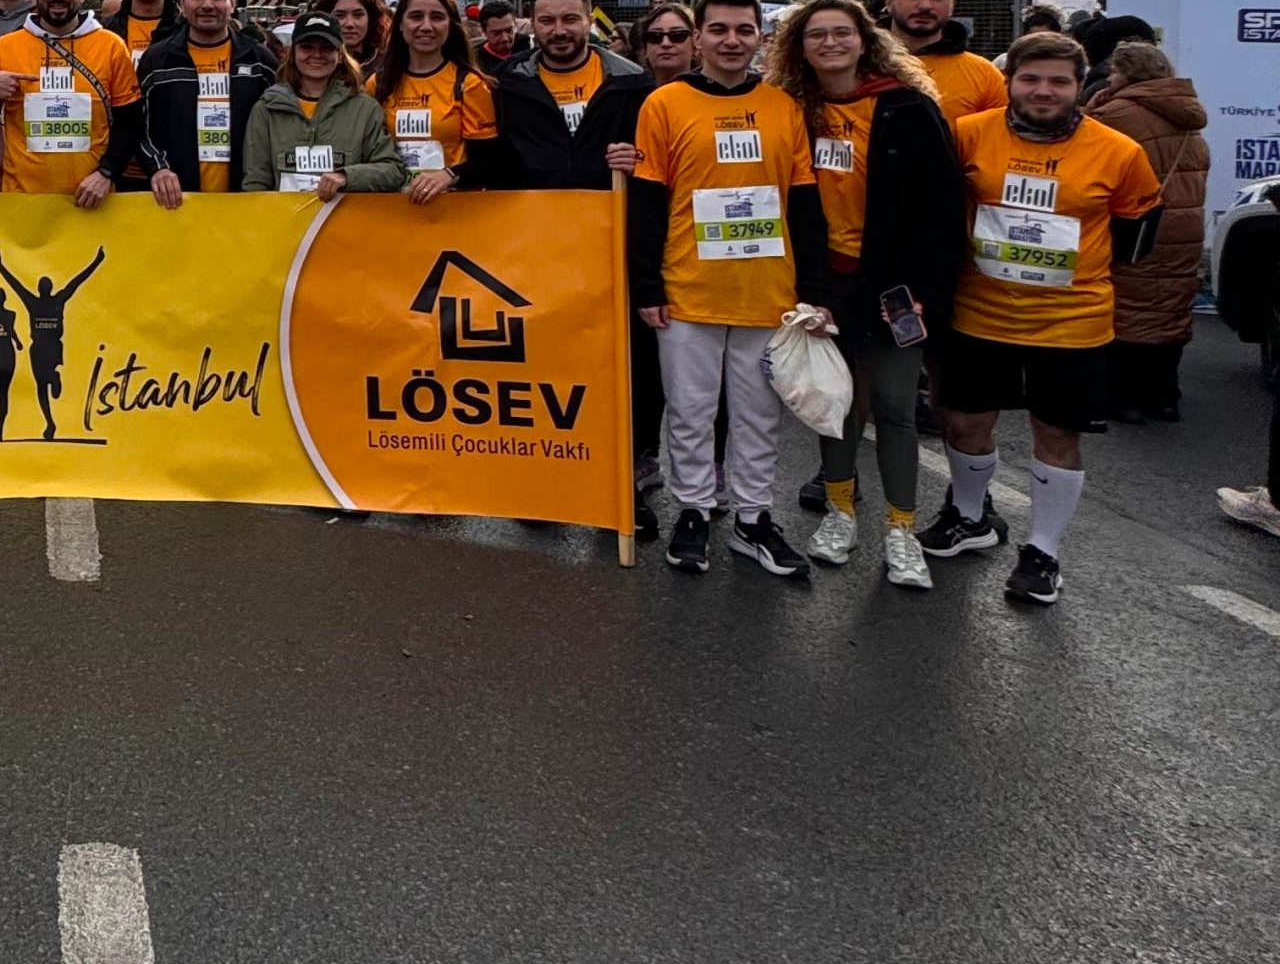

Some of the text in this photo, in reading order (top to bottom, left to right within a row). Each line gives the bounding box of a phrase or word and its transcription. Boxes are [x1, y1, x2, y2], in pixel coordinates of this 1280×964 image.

[1220, 105, 1276, 116] TÜRKİYE
[45, 123, 88, 134] 38005
[203, 132, 230, 143] 380
[729, 221, 774, 237] 37949
[1008, 247, 1067, 267] 37952
[366, 369, 587, 430] LÖSEV
[368, 430, 590, 461] Lösemili Çocuklar Vakfı
